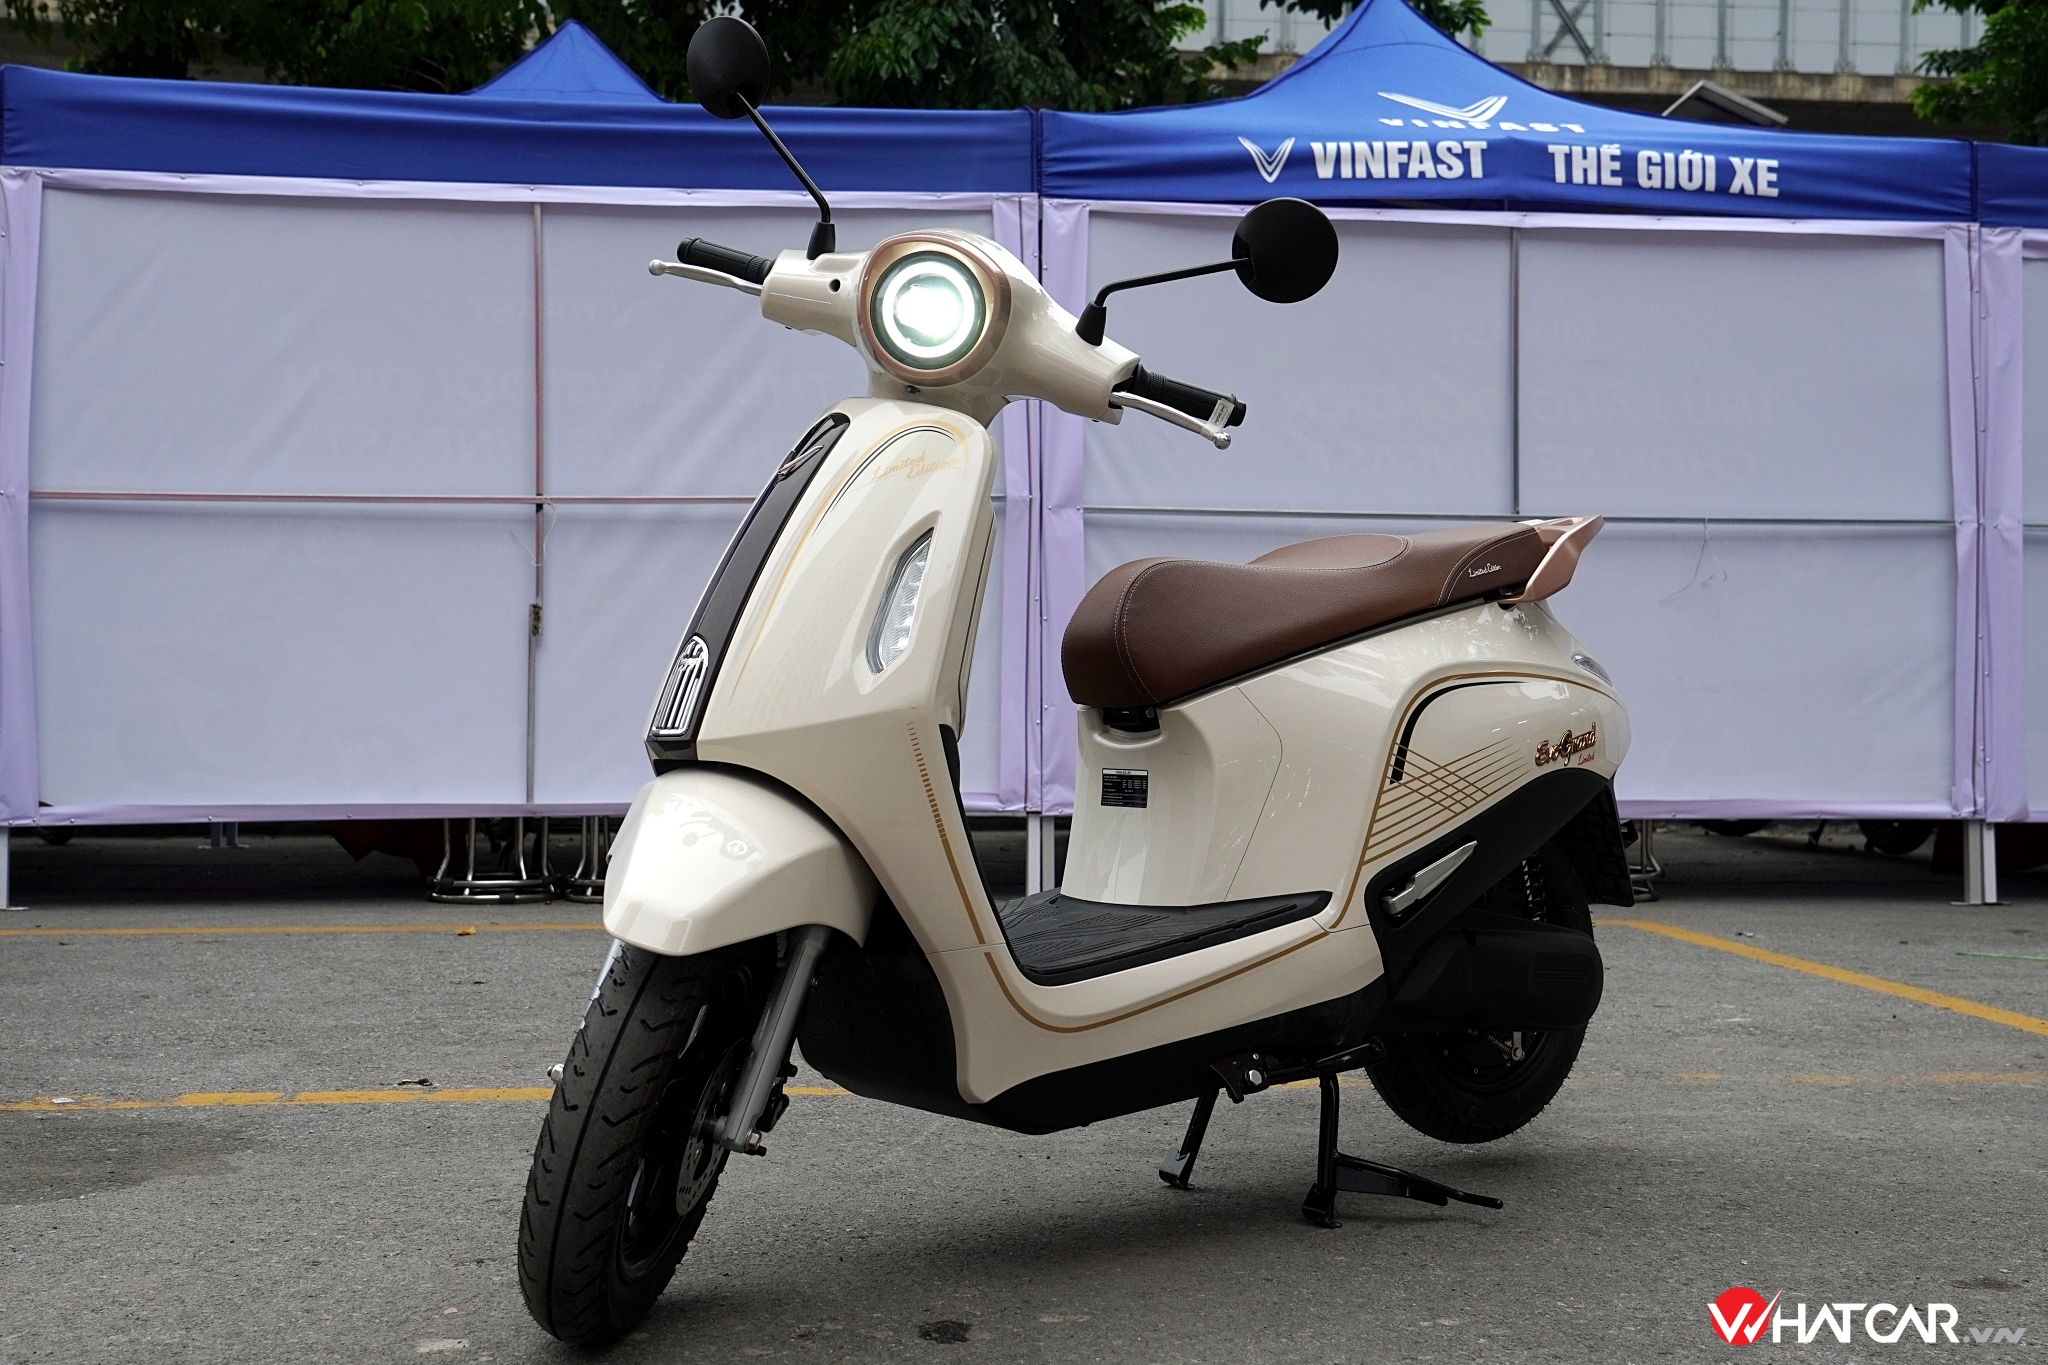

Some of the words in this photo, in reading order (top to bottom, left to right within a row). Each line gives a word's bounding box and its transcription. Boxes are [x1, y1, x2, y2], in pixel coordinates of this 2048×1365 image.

[1378, 117, 1585, 133] VINFAST
[1310, 140, 1487, 179] VINFAST
[1547, 143, 1623, 187] THẾ
[1636, 149, 1717, 193] GIỚI
[1728, 156, 1780, 198] XE
[871, 450, 926, 481] Limited
